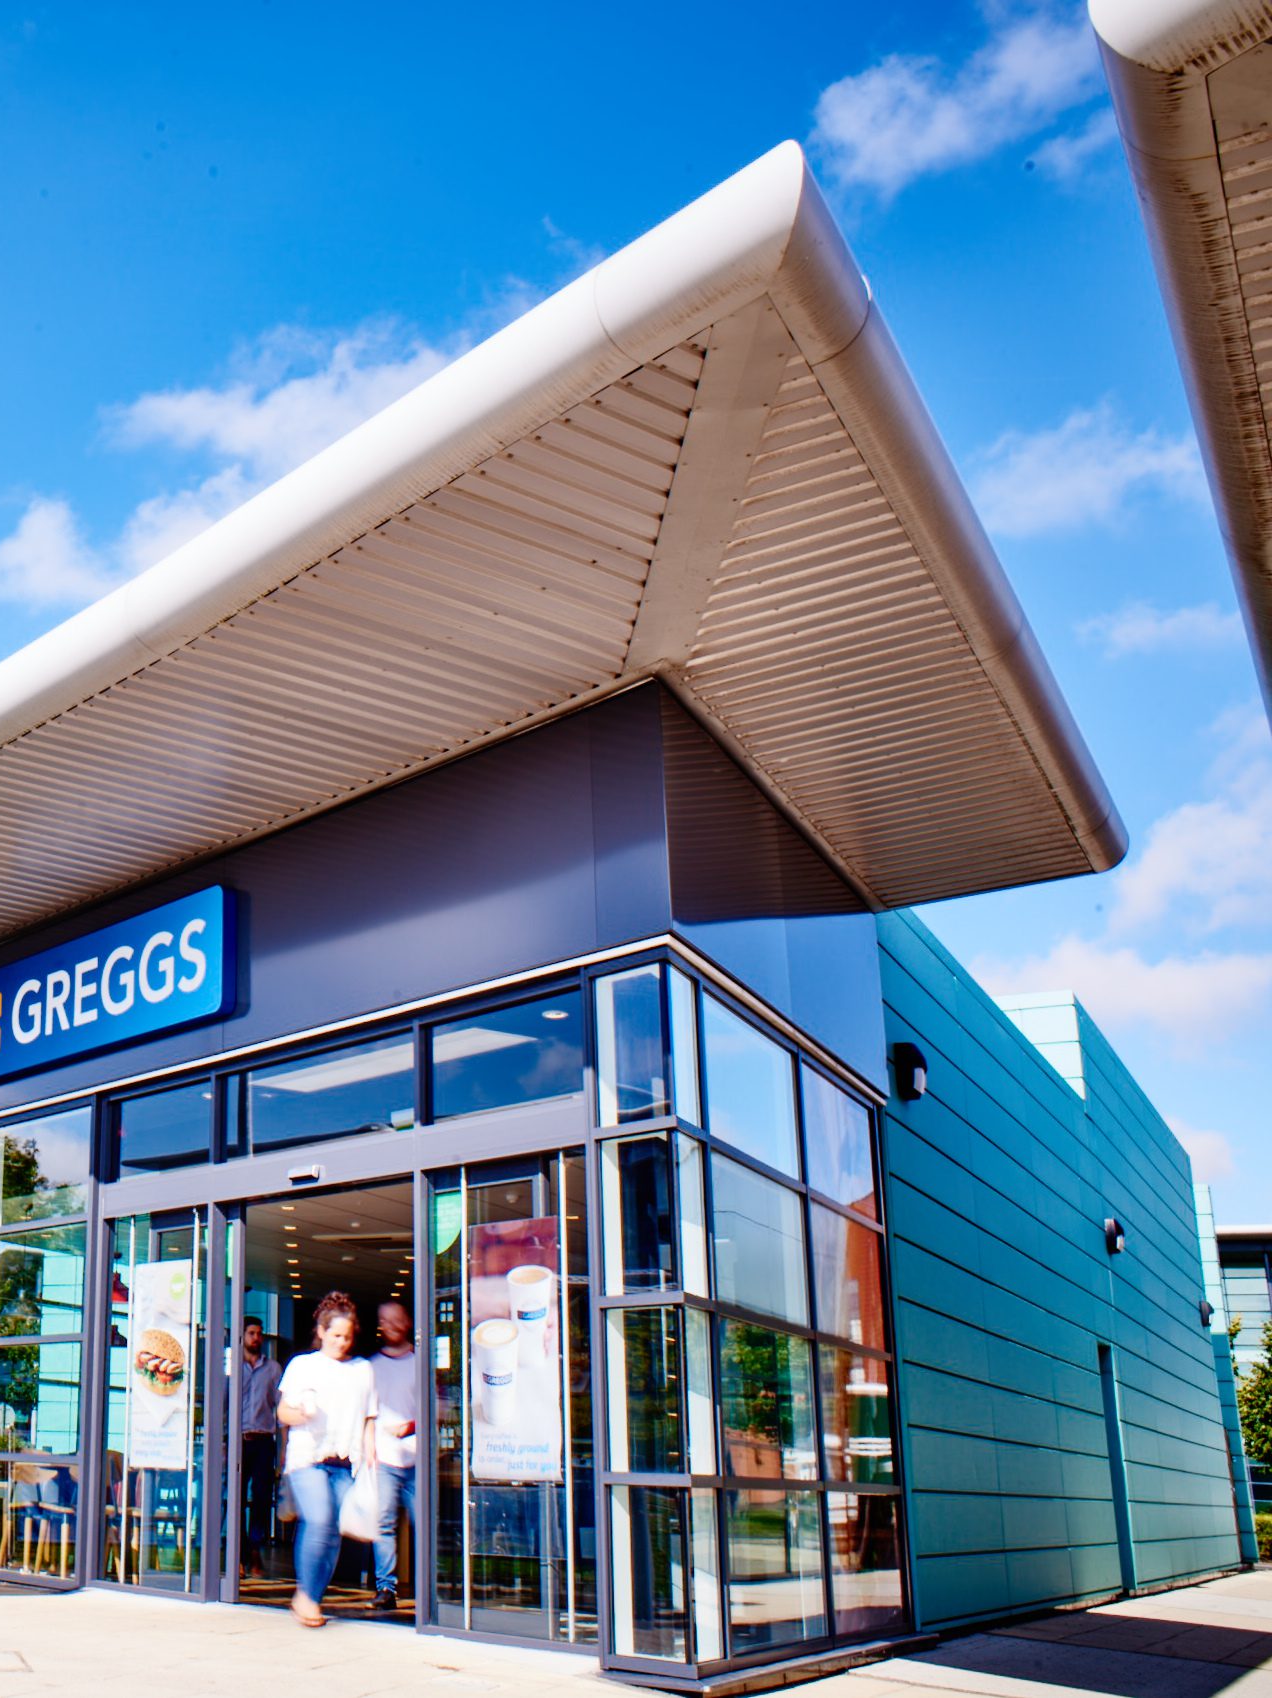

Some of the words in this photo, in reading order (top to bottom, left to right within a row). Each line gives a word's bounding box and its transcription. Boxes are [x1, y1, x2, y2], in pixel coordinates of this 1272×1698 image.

[12, 919, 206, 1044] GREGGS
[486, 1440, 516, 1456] freshly
[518, 1440, 549, 1456] ground
